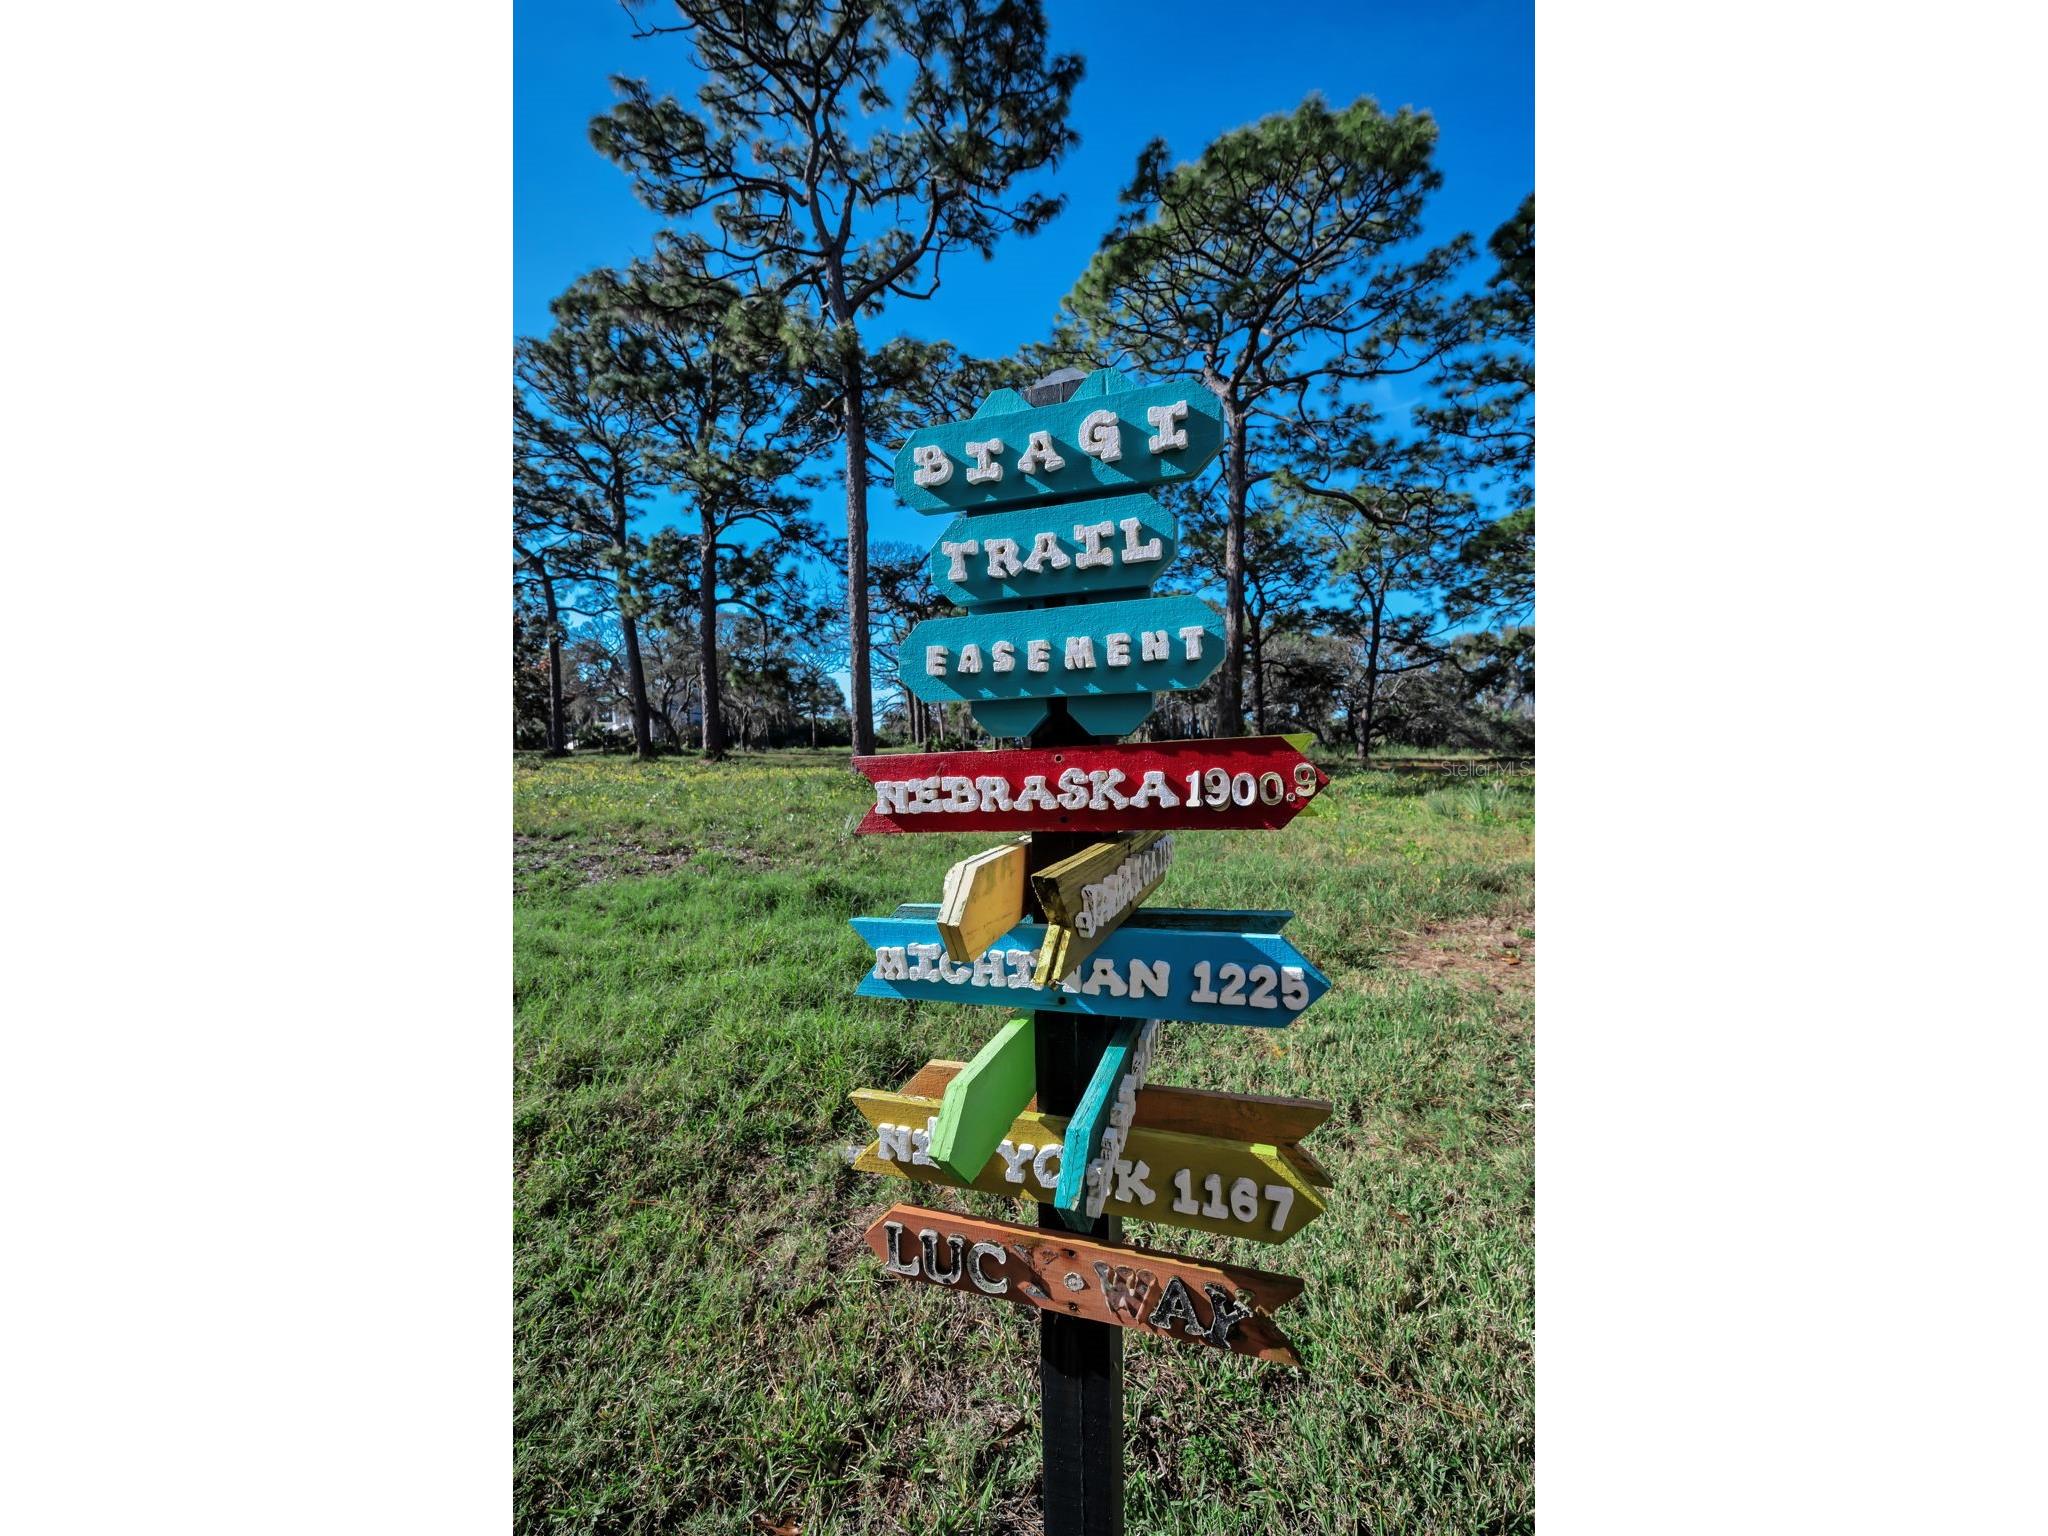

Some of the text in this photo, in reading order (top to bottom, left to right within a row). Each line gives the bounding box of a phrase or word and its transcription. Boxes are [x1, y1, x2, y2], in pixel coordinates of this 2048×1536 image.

[913, 400, 1189, 488] BIAGI
[941, 517, 1163, 582] TRAIL
[925, 625, 1205, 676] EASEMENT
[874, 767, 1180, 815] NEBRASKA
[1190, 960, 1310, 1011] 1225
[996, 1139, 1156, 1206] YOK
[1172, 1168, 1294, 1232] 1167
